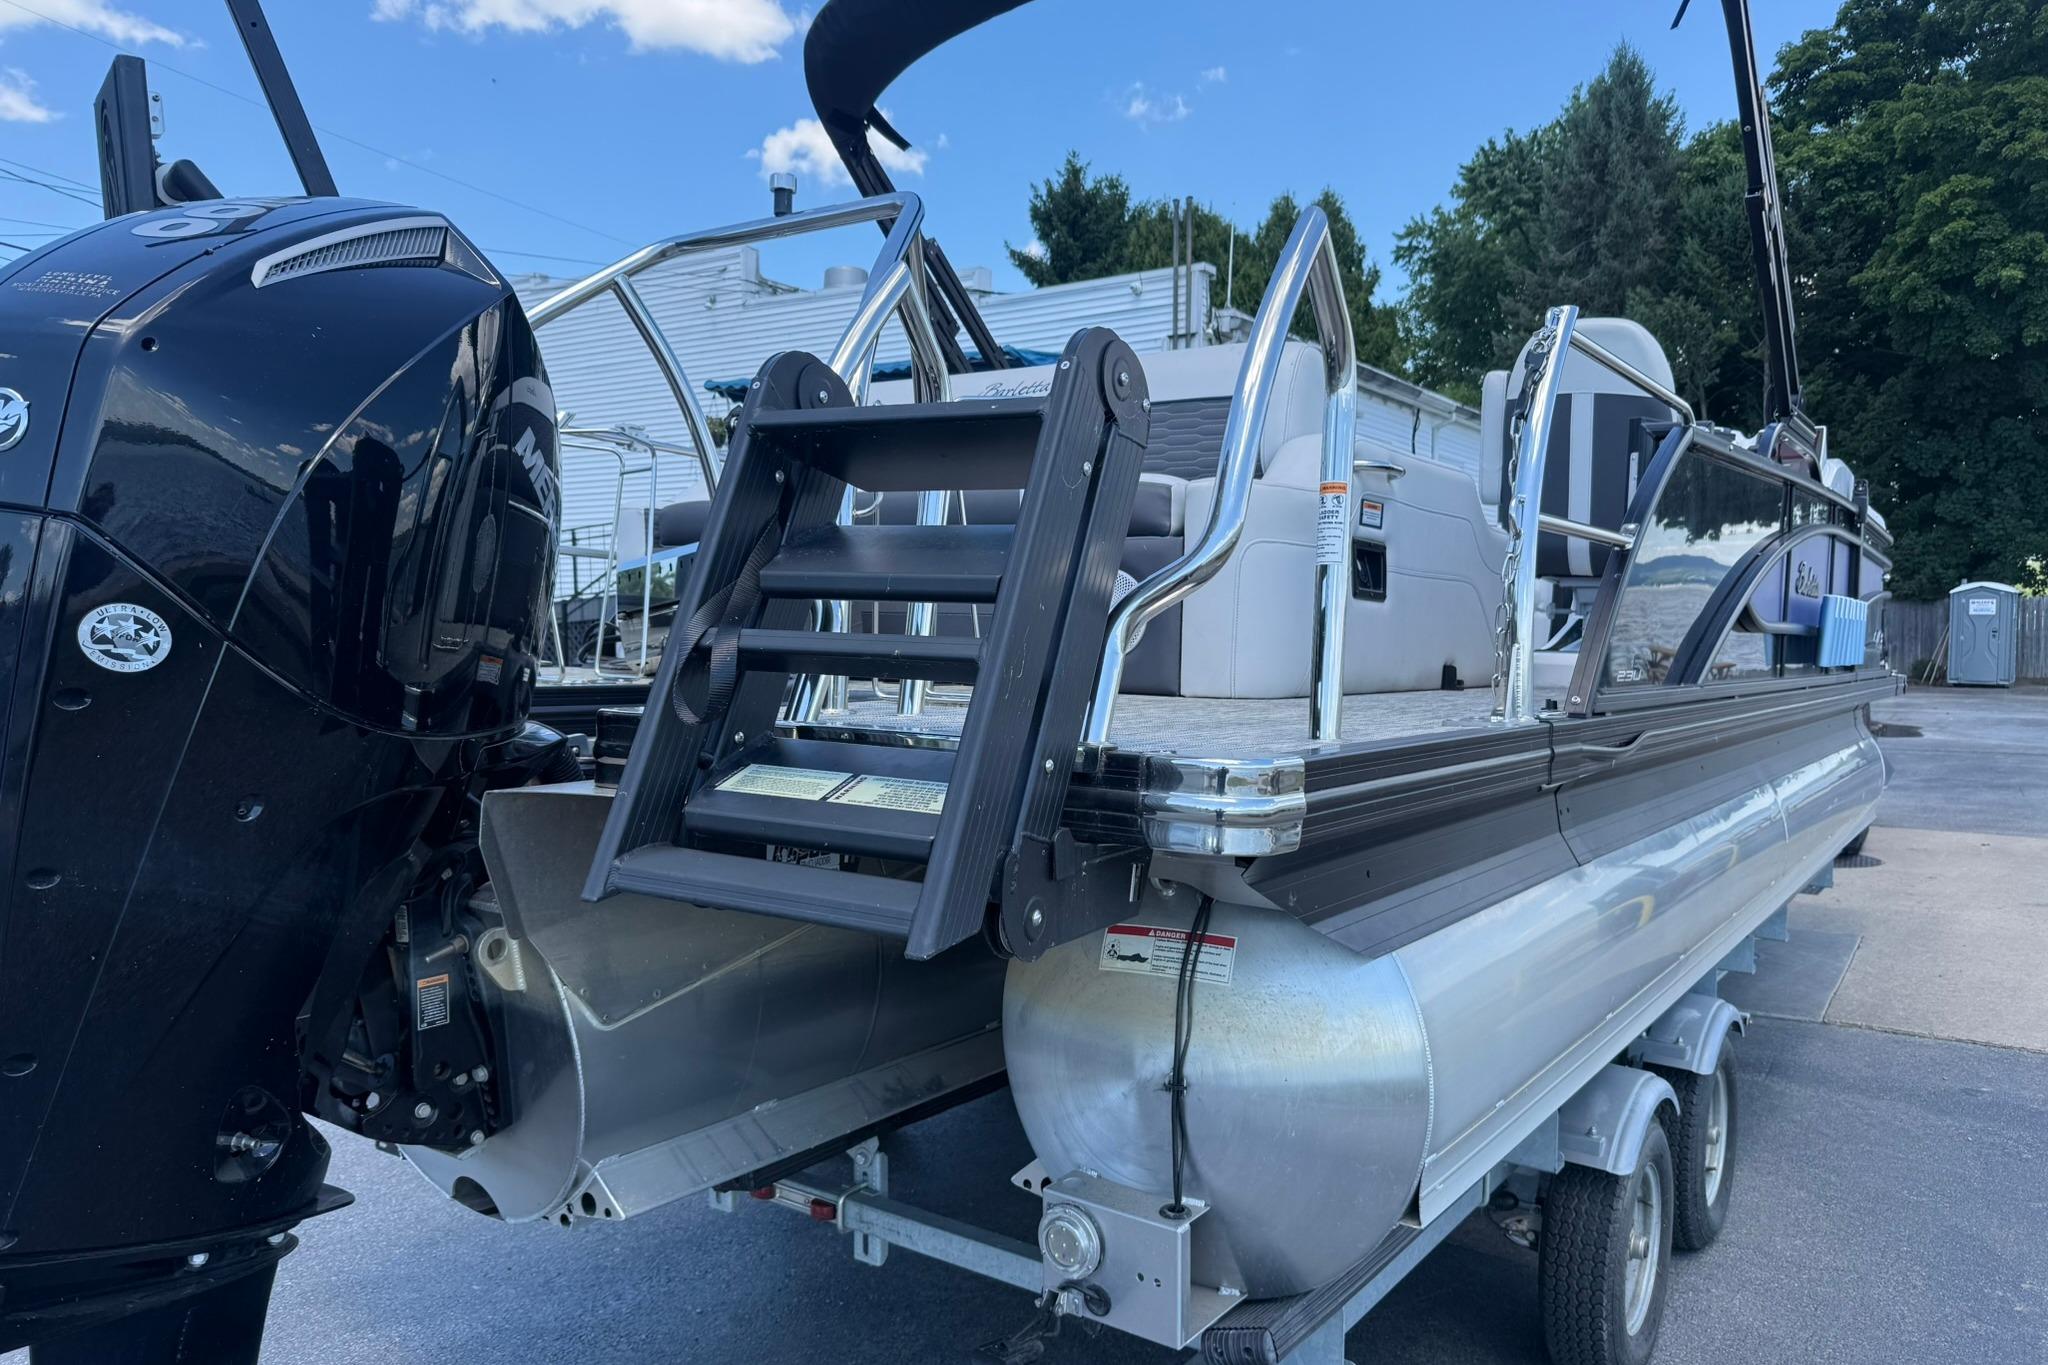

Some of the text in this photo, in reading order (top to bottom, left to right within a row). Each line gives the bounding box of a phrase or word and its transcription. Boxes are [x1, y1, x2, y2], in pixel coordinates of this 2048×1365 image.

[978, 380, 1052, 397] Barletta
[96, 605, 168, 633] ULTRA LOW
[1156, 930, 1187, 940] DANGER
